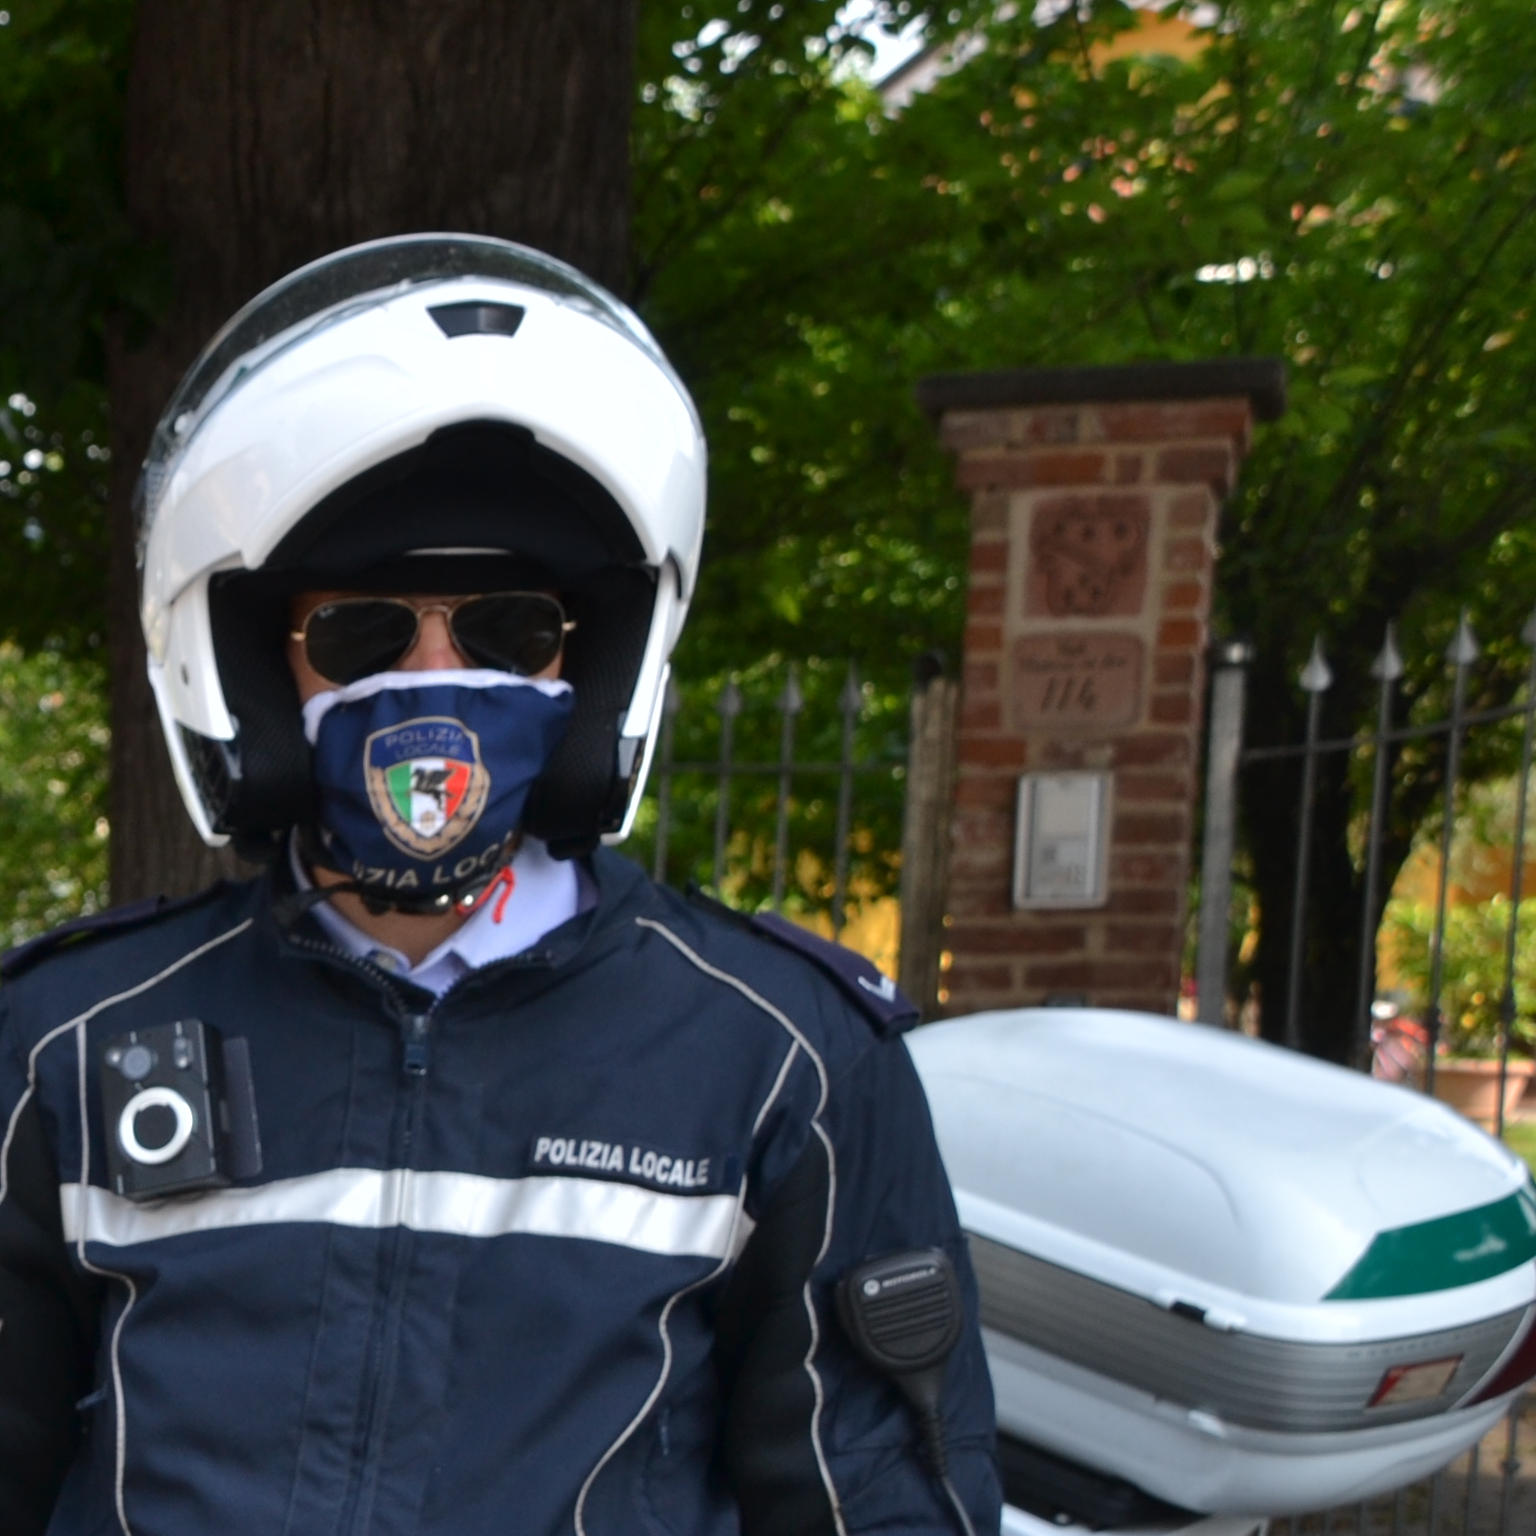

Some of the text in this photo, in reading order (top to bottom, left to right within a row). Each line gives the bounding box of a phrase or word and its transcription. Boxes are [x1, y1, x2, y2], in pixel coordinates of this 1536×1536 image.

[385, 727, 464, 749] POLIZIA
[534, 1136, 710, 1188] POLIZIA LOCALE
